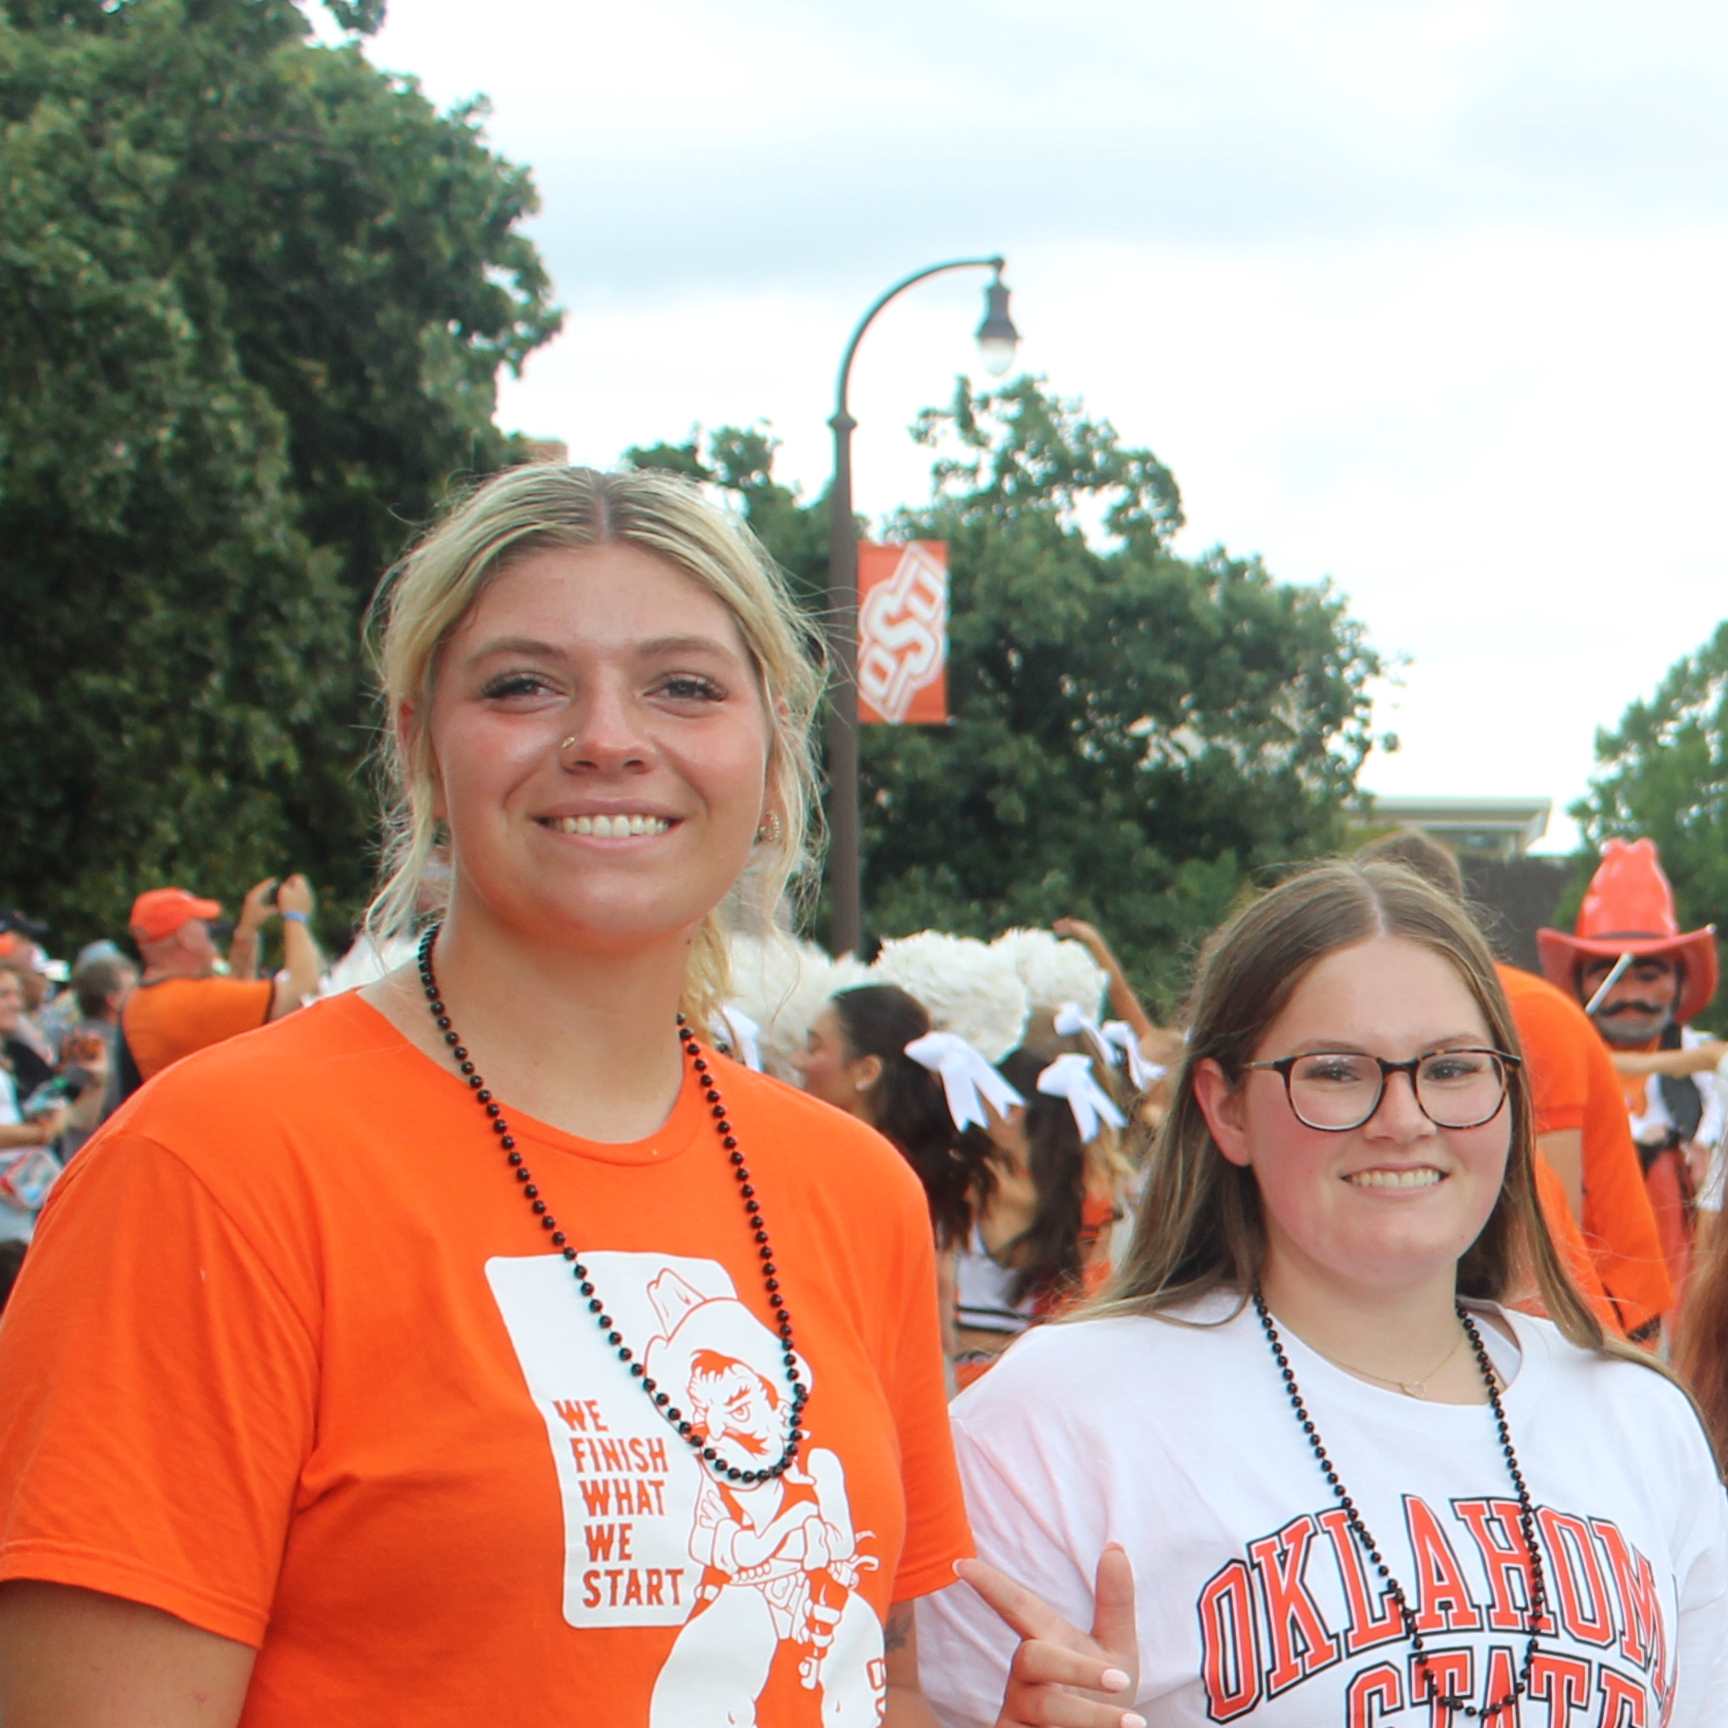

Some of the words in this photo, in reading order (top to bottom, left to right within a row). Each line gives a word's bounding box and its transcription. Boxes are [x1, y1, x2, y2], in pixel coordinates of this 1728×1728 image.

[552, 1399, 609, 1432] WE
[570, 1437, 669, 1474] FINISH
[578, 1479, 666, 1517] WHAT
[584, 1523, 633, 1563] WE
[582, 1567, 684, 1609] START
